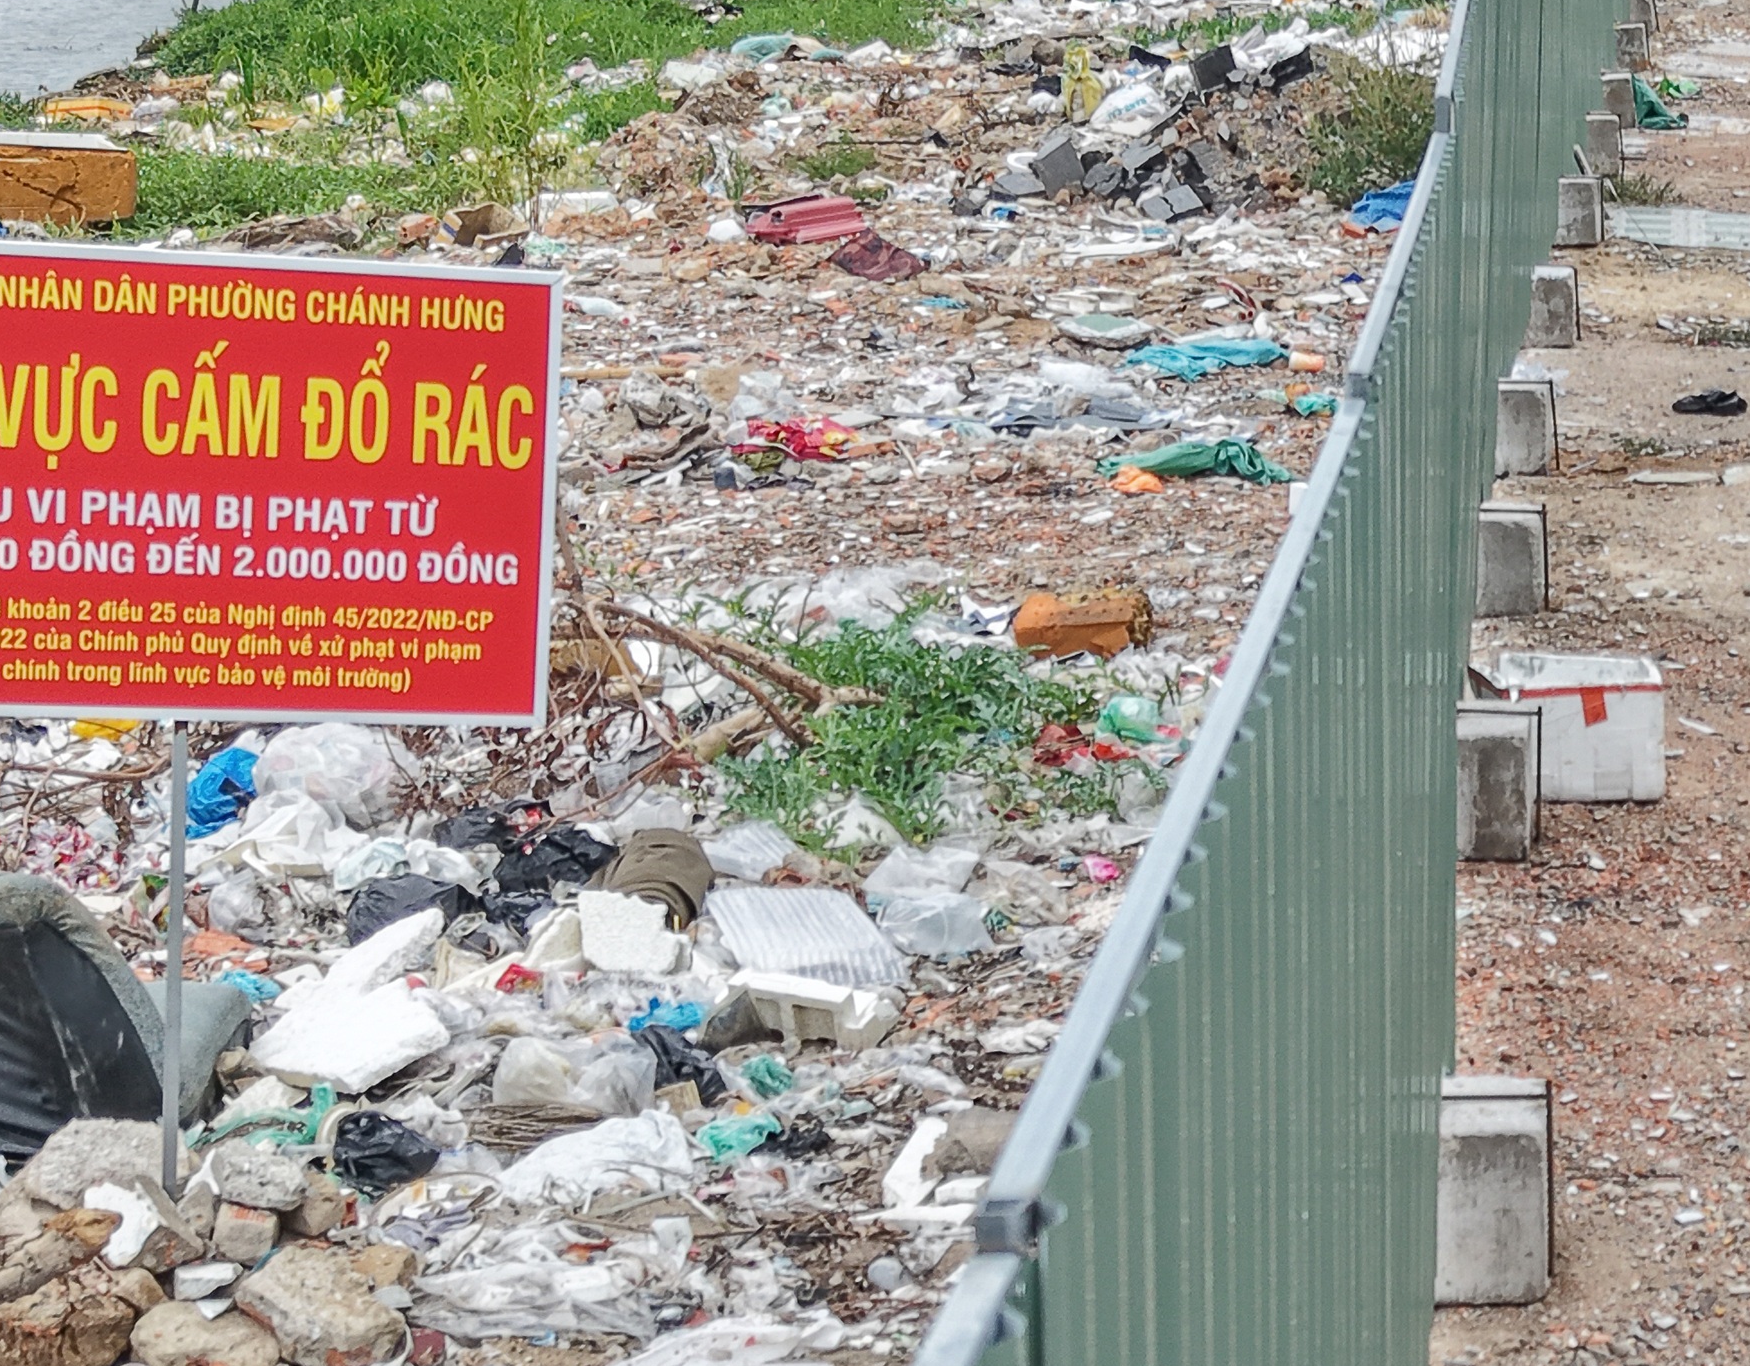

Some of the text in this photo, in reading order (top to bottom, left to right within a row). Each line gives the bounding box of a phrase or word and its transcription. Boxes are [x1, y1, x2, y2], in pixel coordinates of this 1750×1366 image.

[94, 273, 158, 315] DÂN
[167, 279, 296, 322] PHƯỜNG
[306, 285, 411, 327] CHÁNH
[421, 294, 506, 332] HƯNG
[142, 339, 282, 458] CẤM
[300, 339, 391, 464] ĐỔ
[412, 363, 535, 471] RÁC
[26, 488, 67, 525] VI
[81, 489, 201, 536] PHẠM
[215, 494, 254, 539] BỊ
[267, 495, 374, 541] PHẠT
[384, 493, 440, 537] TỪ
[28, 528, 135, 574] ĐỒNG
[146, 532, 221, 576] ĐẾN
[232, 545, 408, 582] 2.000.000
[417, 541, 519, 585] ĐỒNG
[7, 596, 71, 622] khoản
[77, 599, 92, 622] 2
[98, 596, 143, 624] điều
[149, 602, 176, 624] 25
[182, 601, 221, 626] của
[227, 603, 276, 631] Nghị
[281, 605, 326, 632] định
[332, 607, 494, 633] 45/2022/NĐ-CP
[33, 627, 72, 652] của
[78, 628, 139, 653] Chính
[144, 630, 185, 657] phủ
[190, 632, 232, 658] Quy
[237, 633, 282, 660] định
[288, 633, 313, 657] về
[318, 635, 344, 658] xử
[349, 637, 395, 663] phạt
[400, 638, 419, 659] vi
[424, 638, 482, 665] phạm
[1, 657, 61, 682] chính
[66, 661, 122, 687] trong
[128, 660, 168, 684] lĩnh
[173, 664, 211, 688] vực
[216, 662, 256, 686] bảo
[261, 665, 286, 691] vệ
[292, 666, 331, 688] môi
[336, 667, 412, 694] trường)
